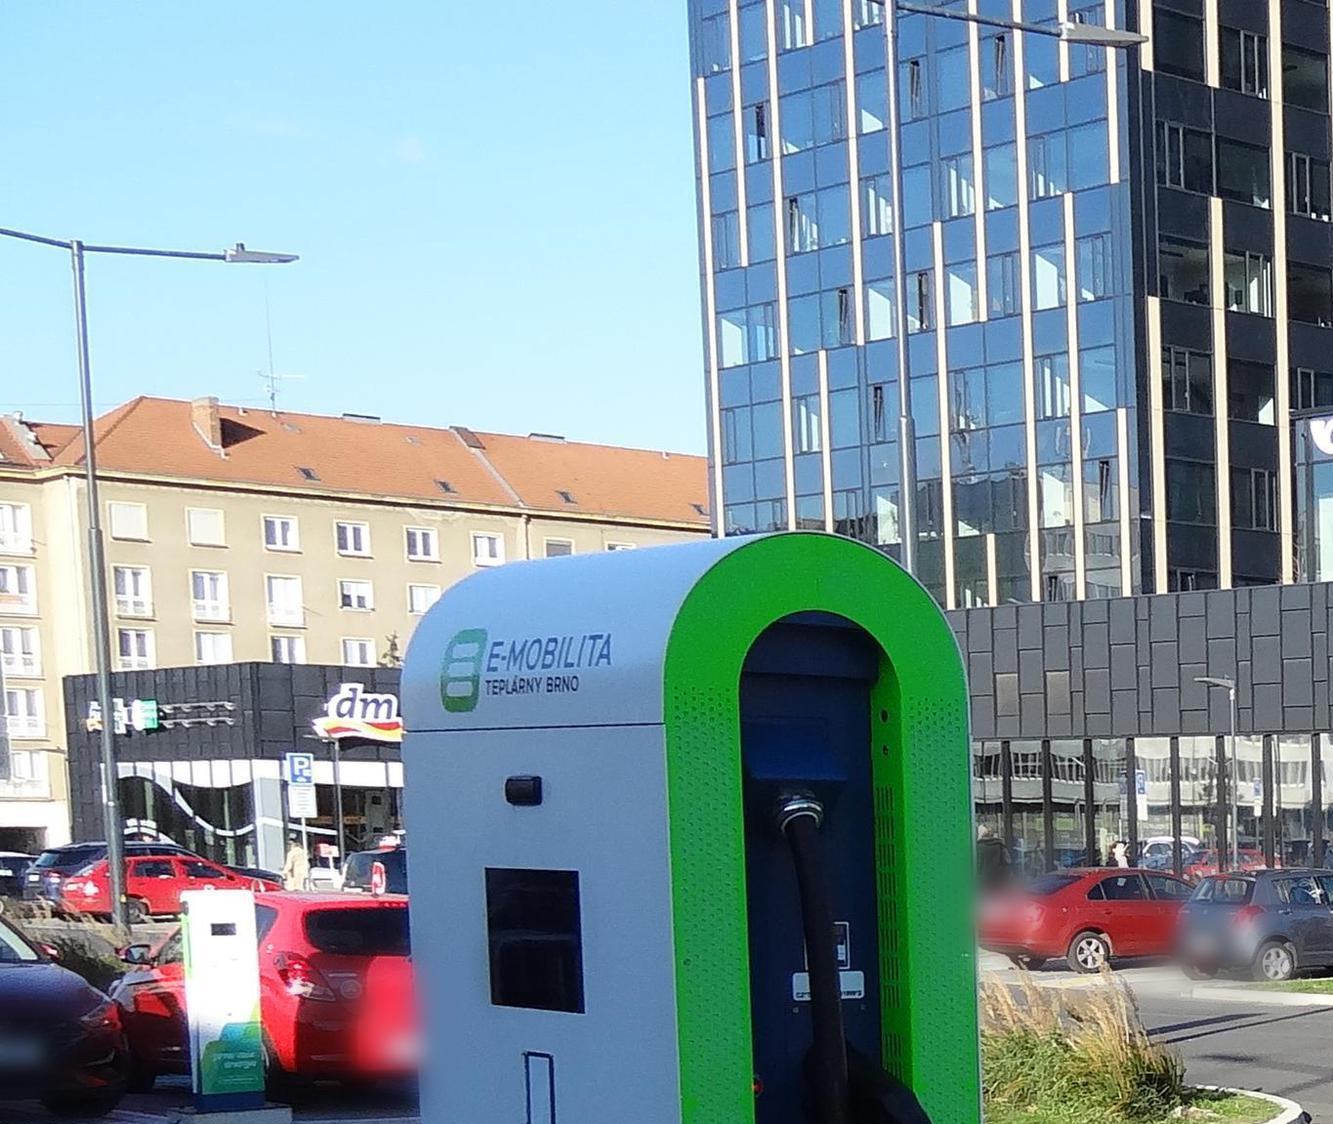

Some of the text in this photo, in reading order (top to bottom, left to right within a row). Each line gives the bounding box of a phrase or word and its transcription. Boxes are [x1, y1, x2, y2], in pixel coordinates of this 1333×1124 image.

[486, 633, 612, 673] E-MOBILITA
[485, 675, 579, 695] TEPLÁRNY BRNO
[336, 687, 393, 719] dm
[293, 757, 308, 776] P
